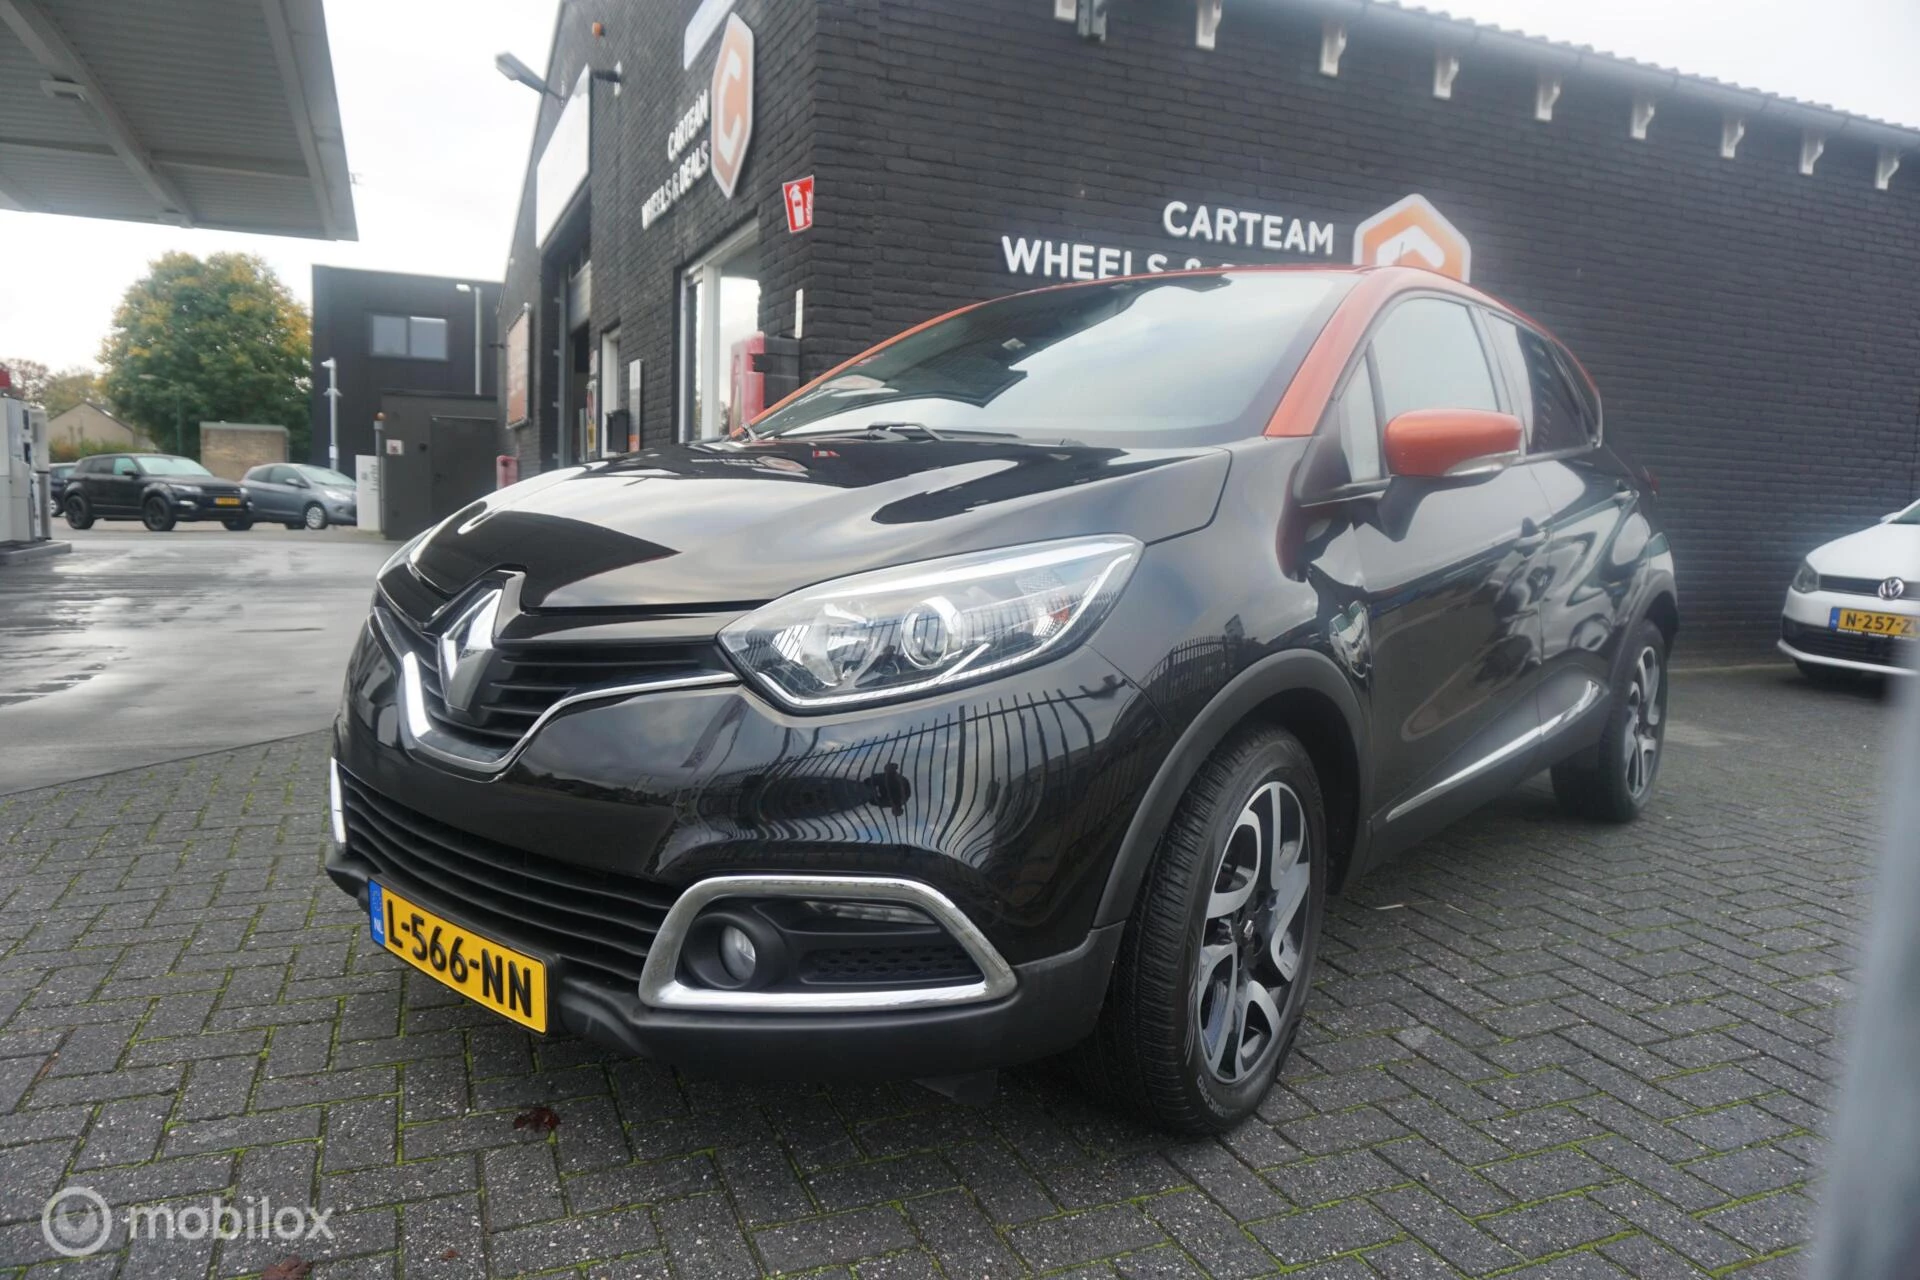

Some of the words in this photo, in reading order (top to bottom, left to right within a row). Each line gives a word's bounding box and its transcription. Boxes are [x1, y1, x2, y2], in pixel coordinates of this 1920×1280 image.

[668, 88, 708, 162] CARTEAM
[1163, 201, 1334, 255] CARTEAM
[387, 899, 532, 1018] L-566-NN
